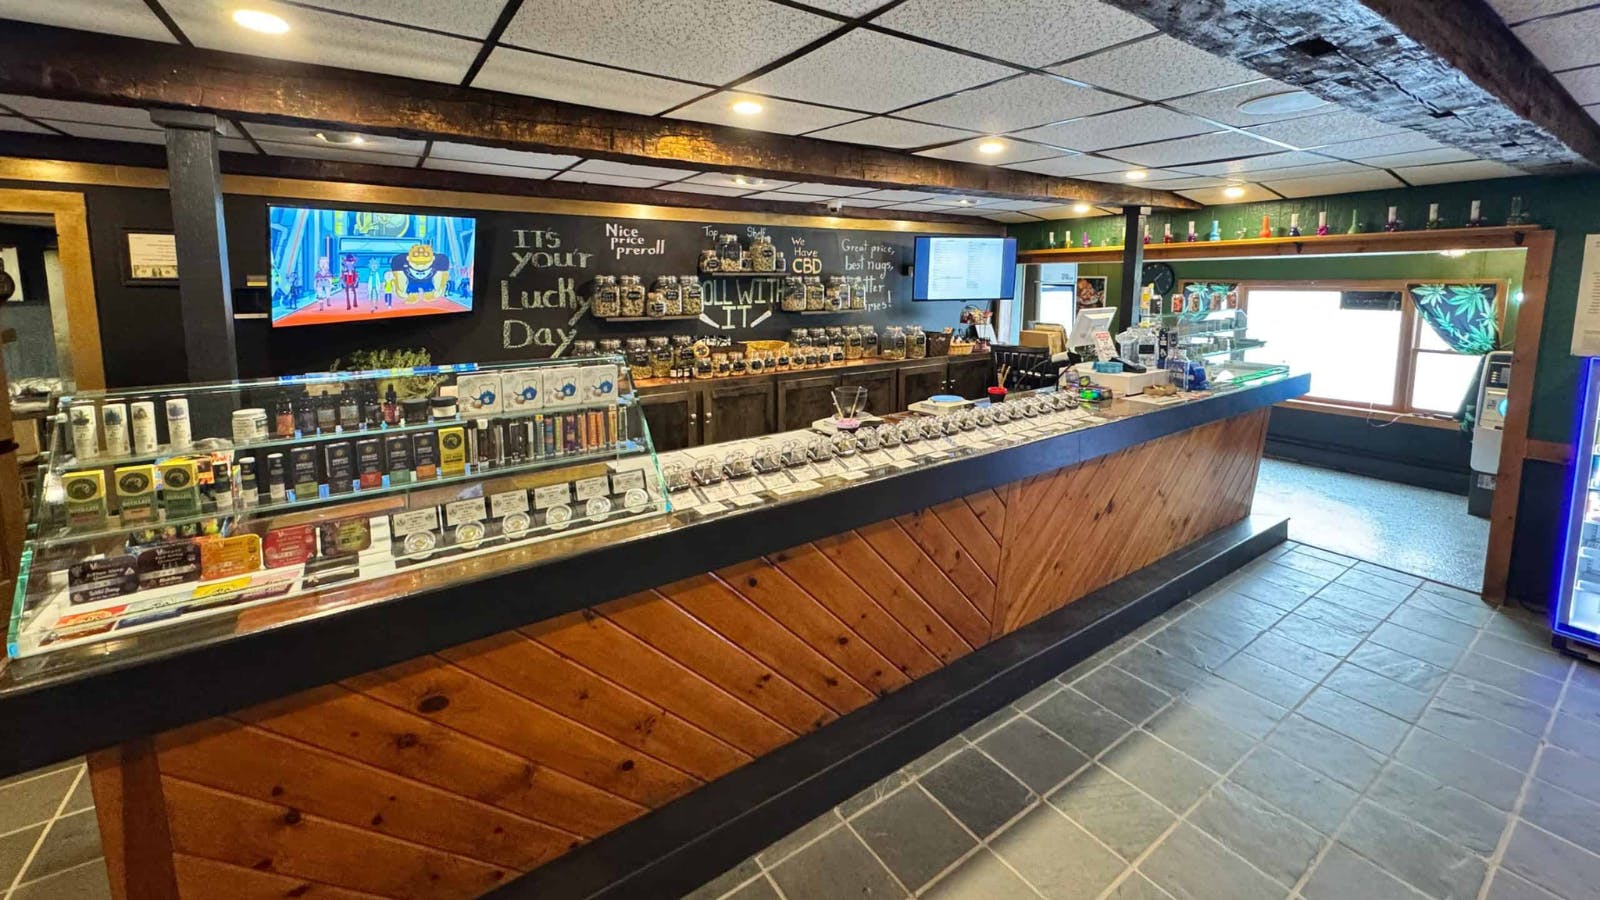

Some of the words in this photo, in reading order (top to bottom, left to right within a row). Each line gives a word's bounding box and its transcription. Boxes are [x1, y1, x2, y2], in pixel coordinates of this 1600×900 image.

[605, 223, 639, 237] Nice
[702, 225, 719, 241] Top
[610, 237, 645, 250] price
[616, 239, 665, 260] preroll
[791, 237, 805, 247] We
[794, 247, 818, 257] Have
[841, 238, 869, 252] Great
[870, 245, 895, 259] price,
[792, 257, 823, 274] CBD
[845, 255, 865, 271] best
[867, 260, 894, 279] nugs,
[501, 277, 592, 326] Lucky
[702, 279, 733, 306] OLL
[721, 304, 753, 330] IT
[503, 319, 577, 359] Day
